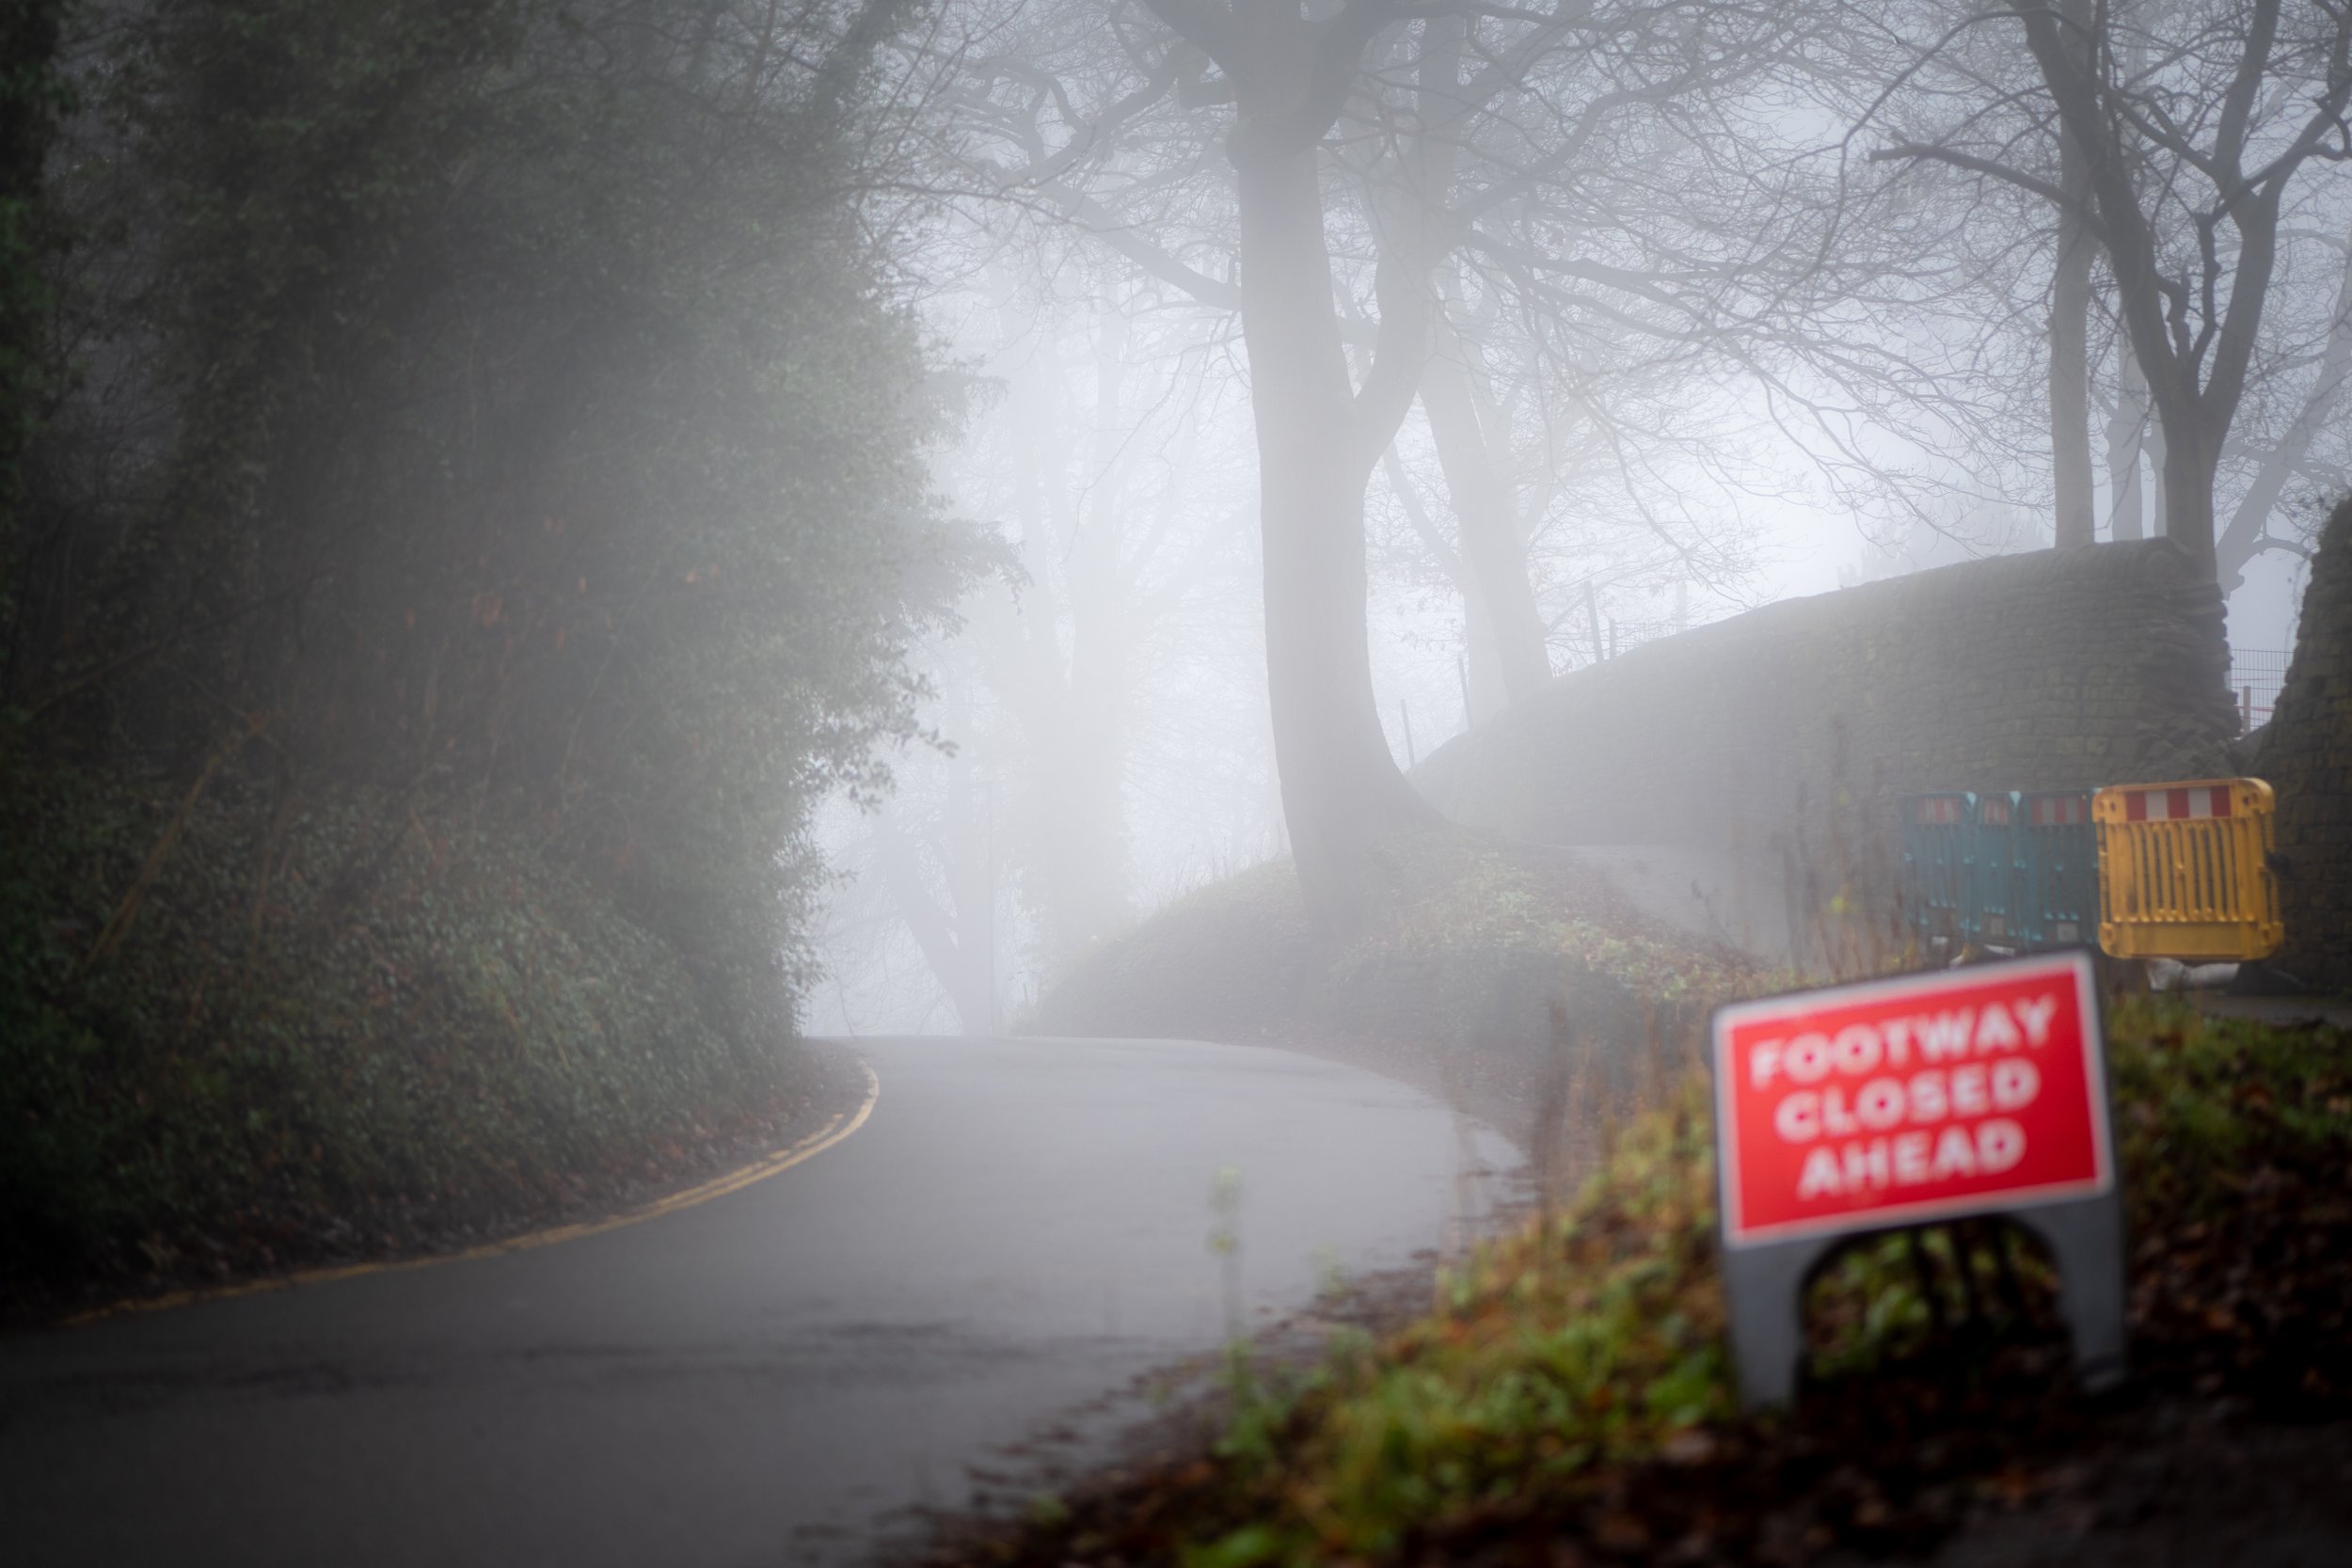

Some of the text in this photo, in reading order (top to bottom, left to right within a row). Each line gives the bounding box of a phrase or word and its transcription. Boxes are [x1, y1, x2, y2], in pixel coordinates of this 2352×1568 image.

[1750, 995, 2056, 1088] FOOTWAY
[1775, 1058, 2040, 1142] CLOSED
[1798, 1119, 2026, 1199] AHEAD
